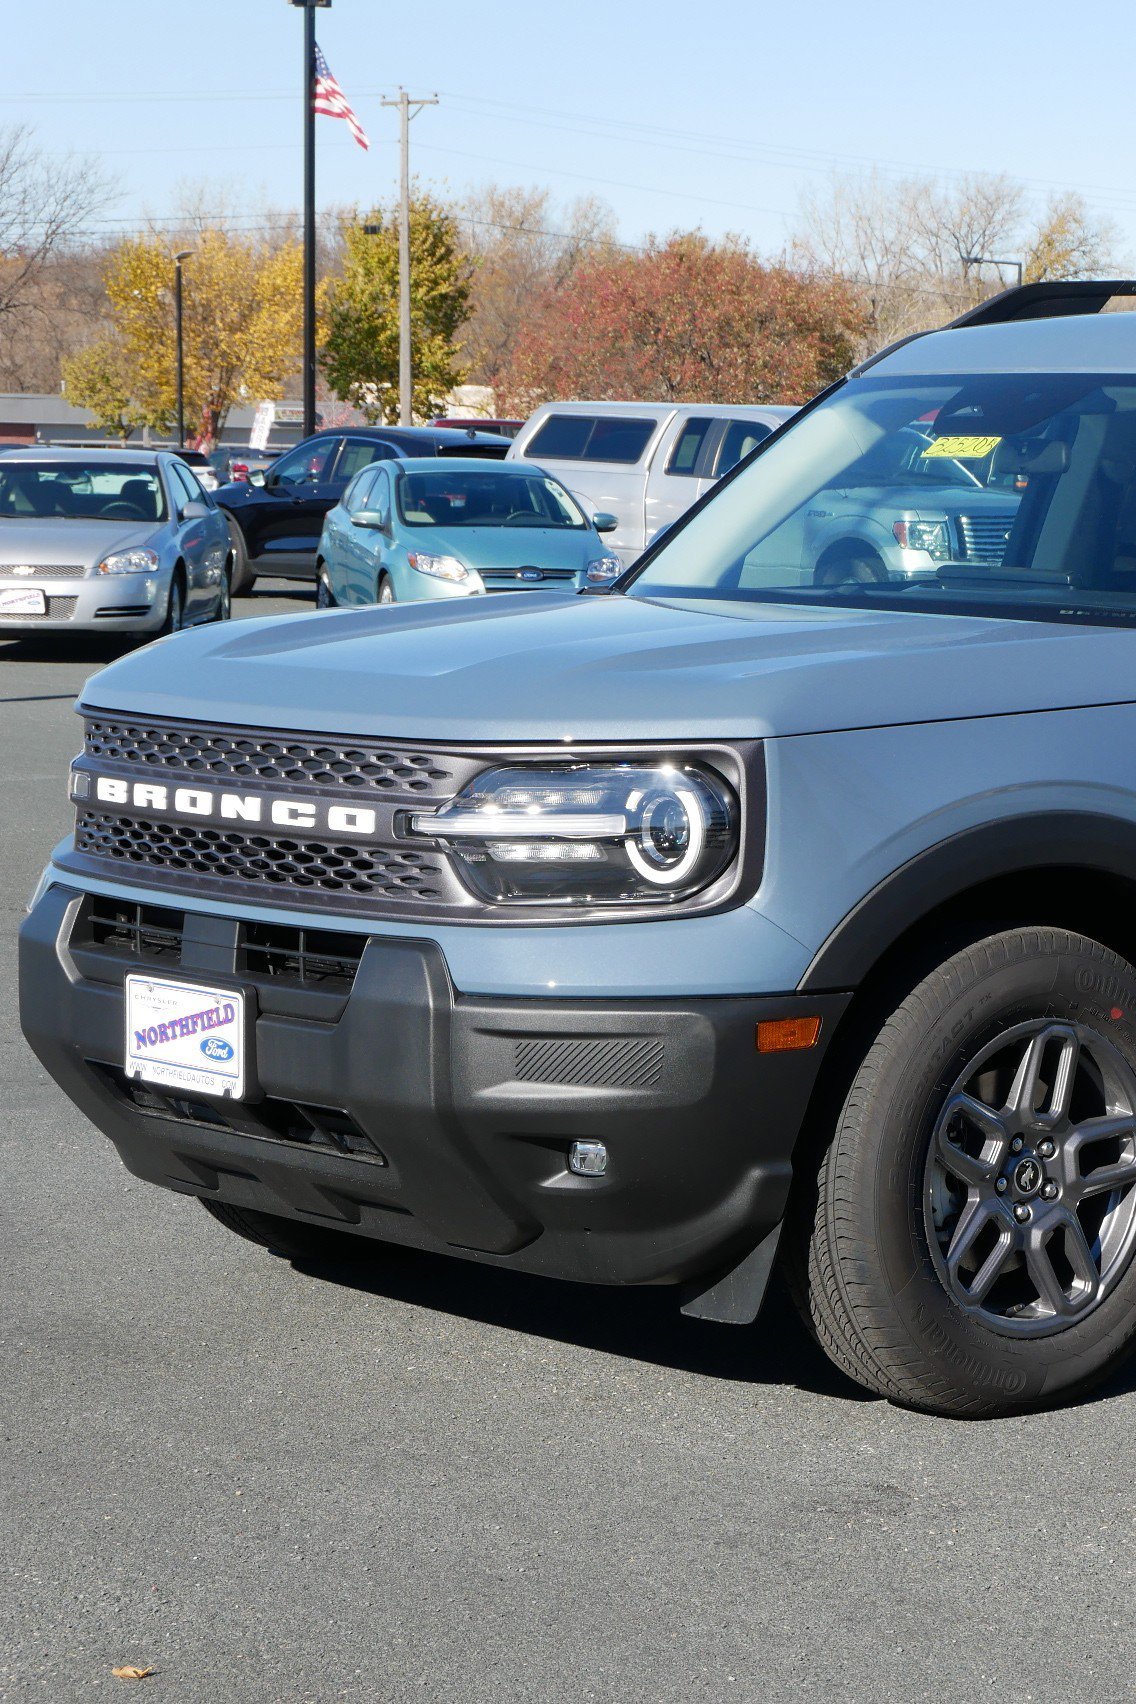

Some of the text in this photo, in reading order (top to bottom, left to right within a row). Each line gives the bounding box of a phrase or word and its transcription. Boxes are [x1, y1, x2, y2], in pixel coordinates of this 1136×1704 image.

[97, 777, 376, 834] BRONCO
[134, 994, 178, 1006] CHRYSLER
[134, 1003, 235, 1050] NORTHFIELD
[205, 1040, 229, 1058] Ford
